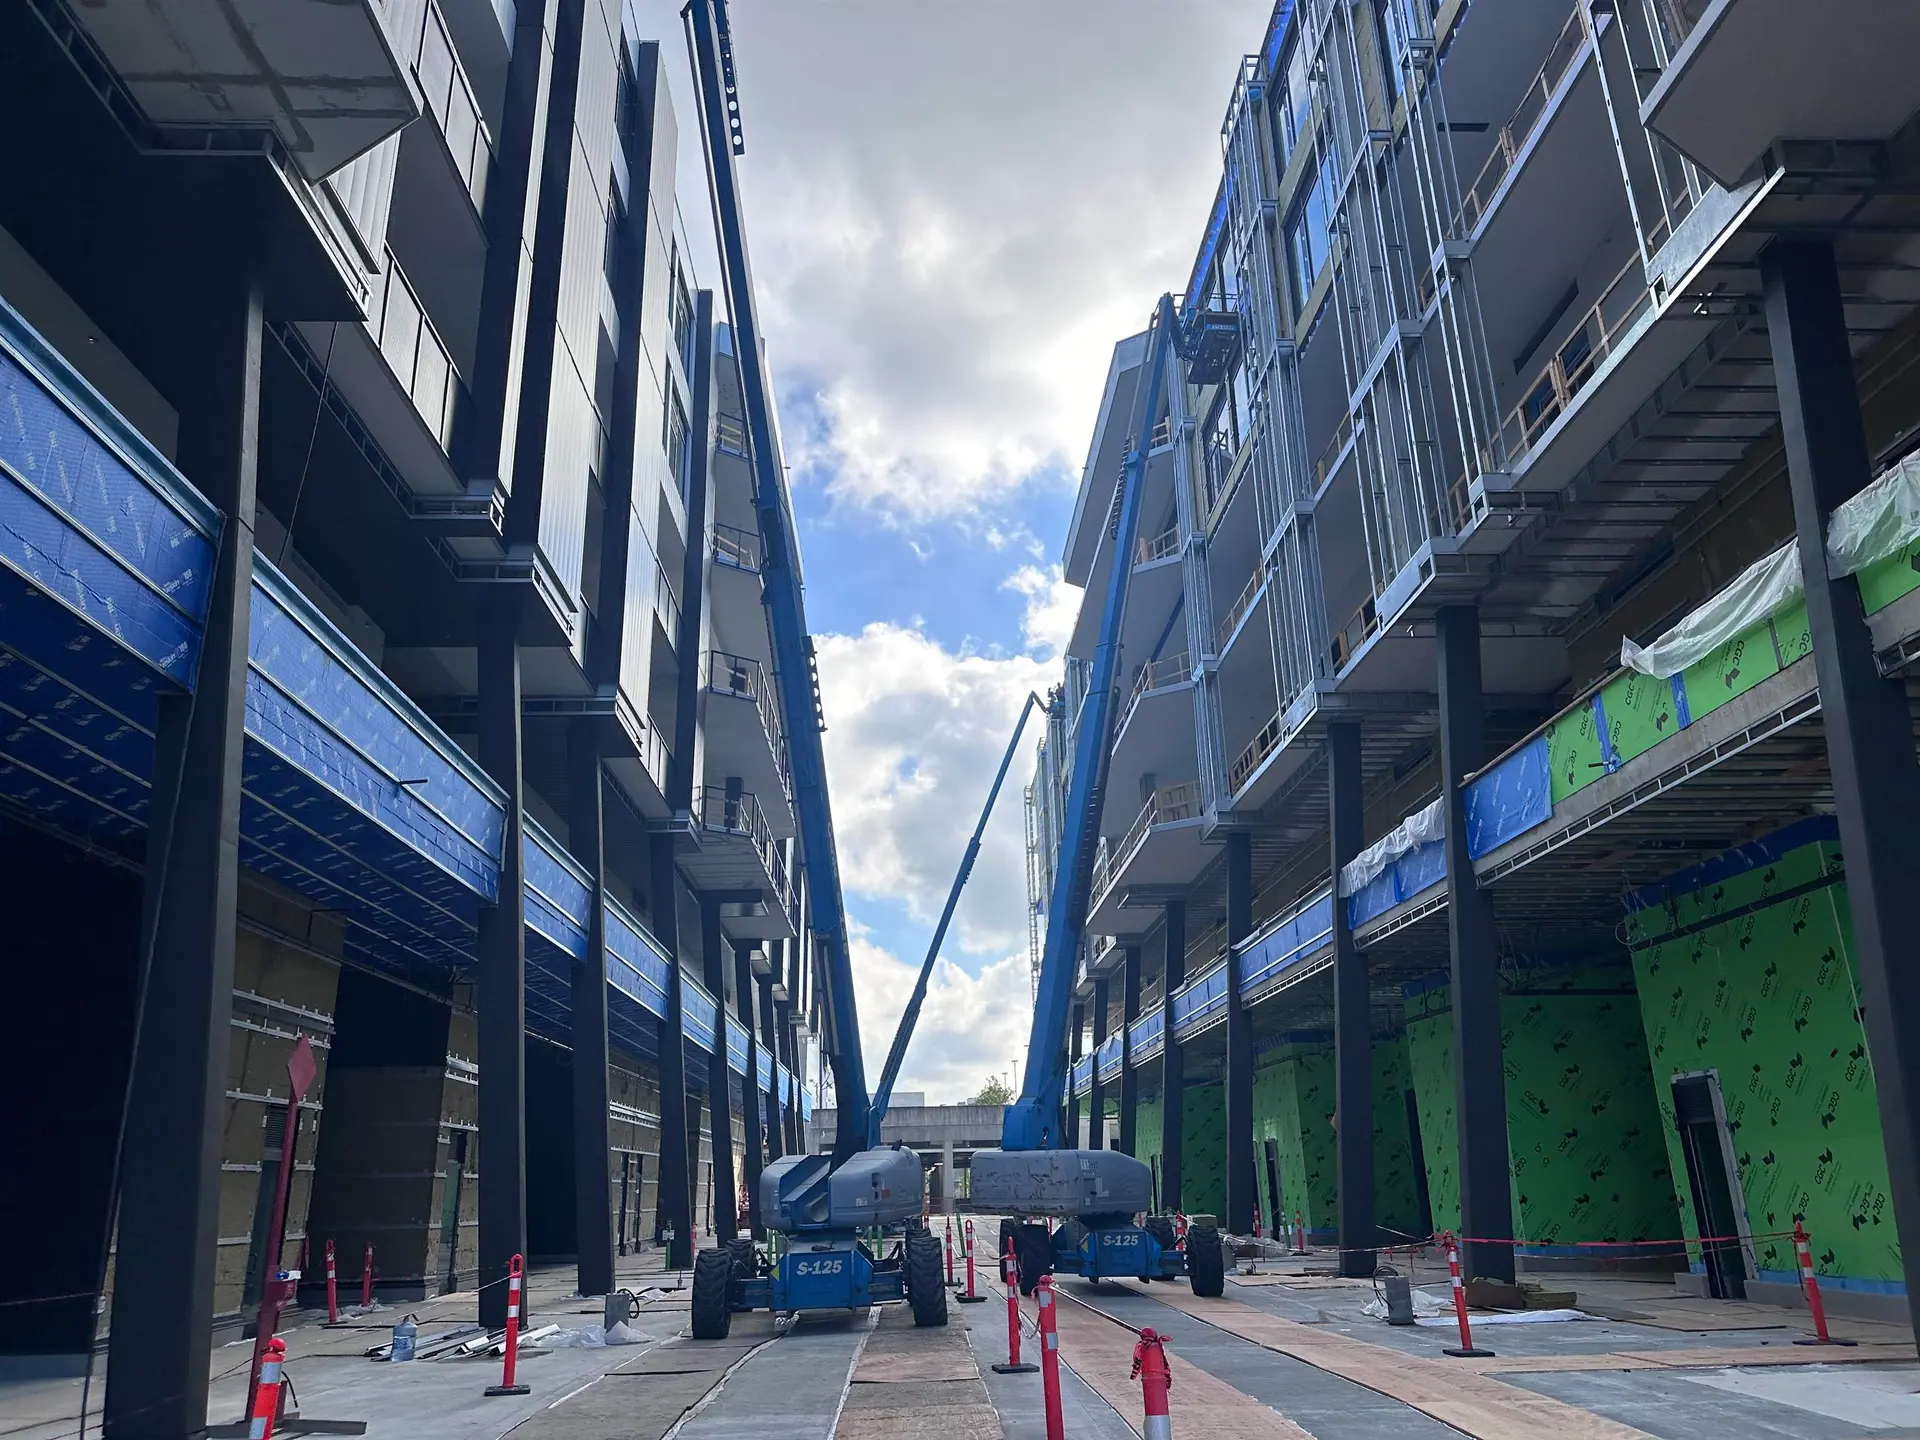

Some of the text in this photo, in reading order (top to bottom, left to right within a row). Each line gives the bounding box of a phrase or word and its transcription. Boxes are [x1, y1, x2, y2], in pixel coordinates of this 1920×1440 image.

[1732, 640, 1745, 667] CGC
[1624, 682, 1635, 706] CGC
[1579, 714, 1589, 737] CGC
[1611, 720, 1622, 743] CGC
[1800, 897, 1811, 919] CGC
[1745, 915, 1756, 935] CGC
[1816, 963, 1829, 986] CGC
[1714, 988, 1724, 1008] CGC
[1761, 977, 1771, 998] CGC
[1747, 1006, 1757, 1027] CGC
[1802, 995, 1813, 1017] CGC
[1701, 1016, 1711, 1036] CGC
[1785, 1068, 1797, 1089] CGC
[1845, 1060, 1857, 1082] CGC
[1748, 1073, 1759, 1094] CGC
[1524, 1090, 1539, 1104] CGC
[1770, 1096, 1781, 1118] CGC
[1828, 1091, 1840, 1113] CGC
[1557, 1137, 1570, 1153] CGC
[1814, 1164, 1826, 1185] CGC
[1798, 1191, 1810, 1213] CGC
[1872, 1192, 1886, 1215] CGC
[1103, 1235, 1139, 1246] S-125
[796, 1259, 842, 1276] S-125
